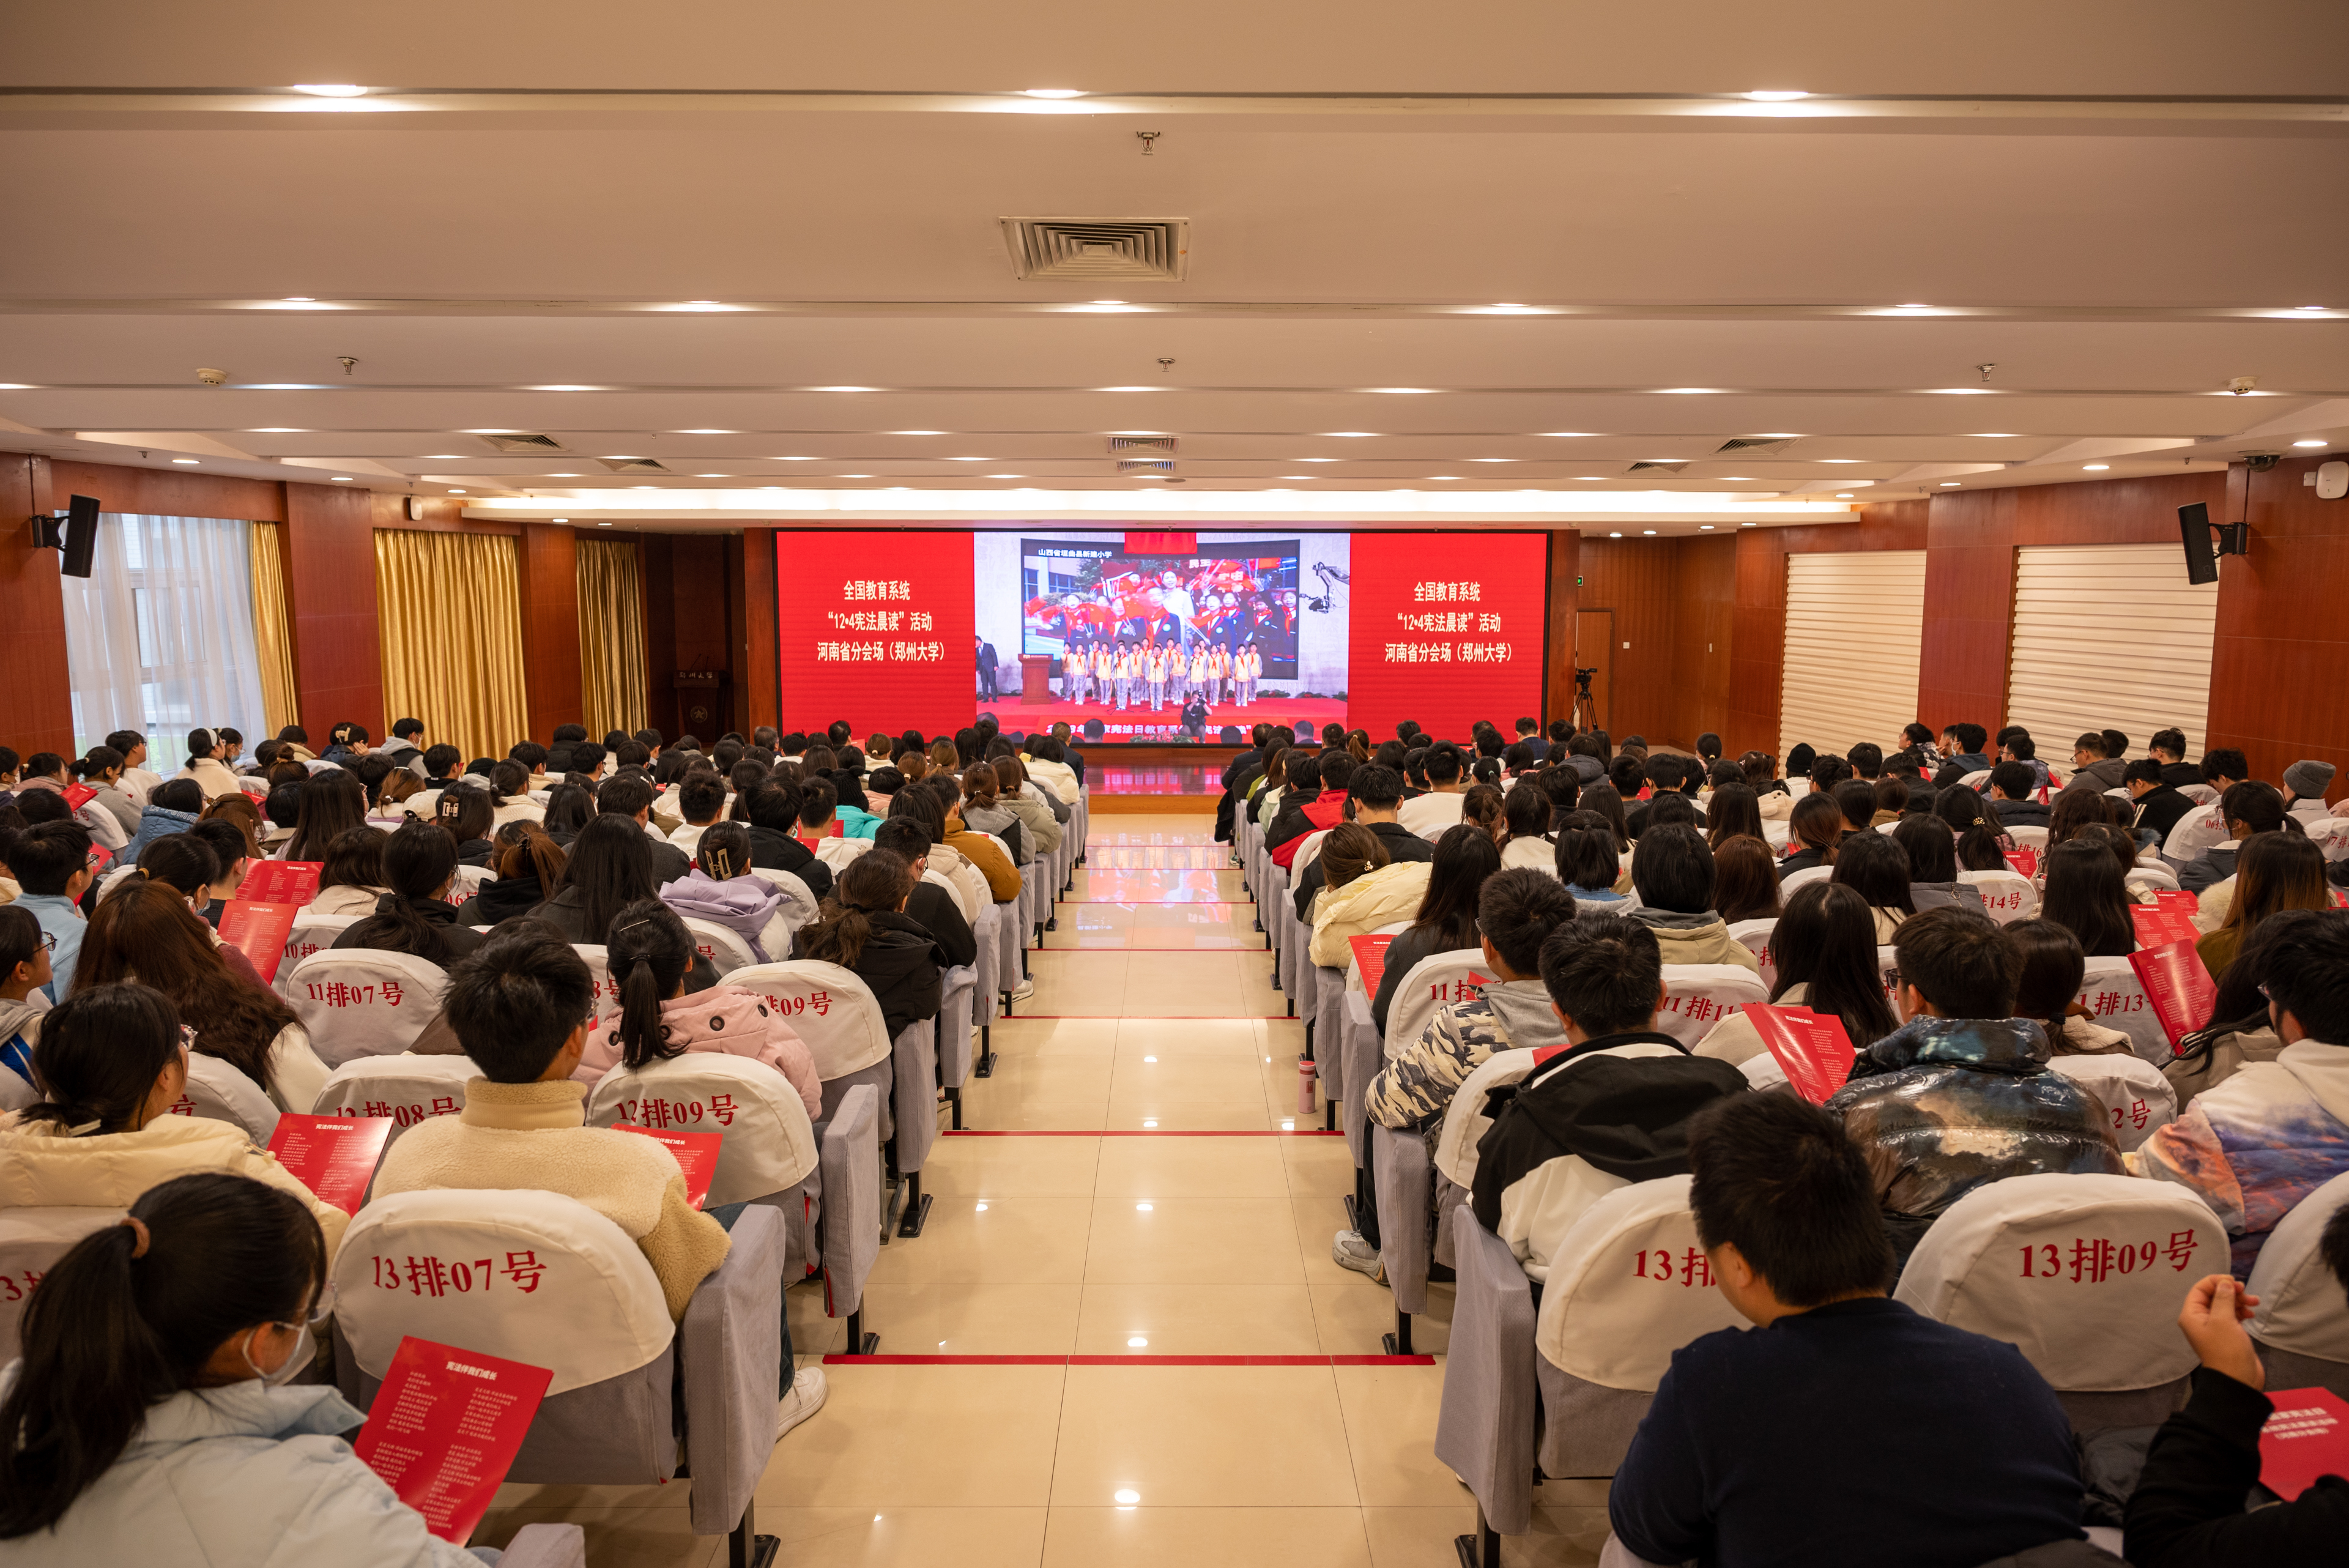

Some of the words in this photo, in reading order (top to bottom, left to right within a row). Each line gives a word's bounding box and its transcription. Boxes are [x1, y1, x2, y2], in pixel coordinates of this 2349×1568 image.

[844, 580, 910, 601] 全国教育系统
[1414, 581, 1480, 601] 全国教育系统
[306, 981, 405, 1008] 11排07号
[614, 1093, 740, 1129] 12排09号
[2019, 1228, 2199, 1284] 13排09号
[371, 1250, 547, 1298] 13排07号
